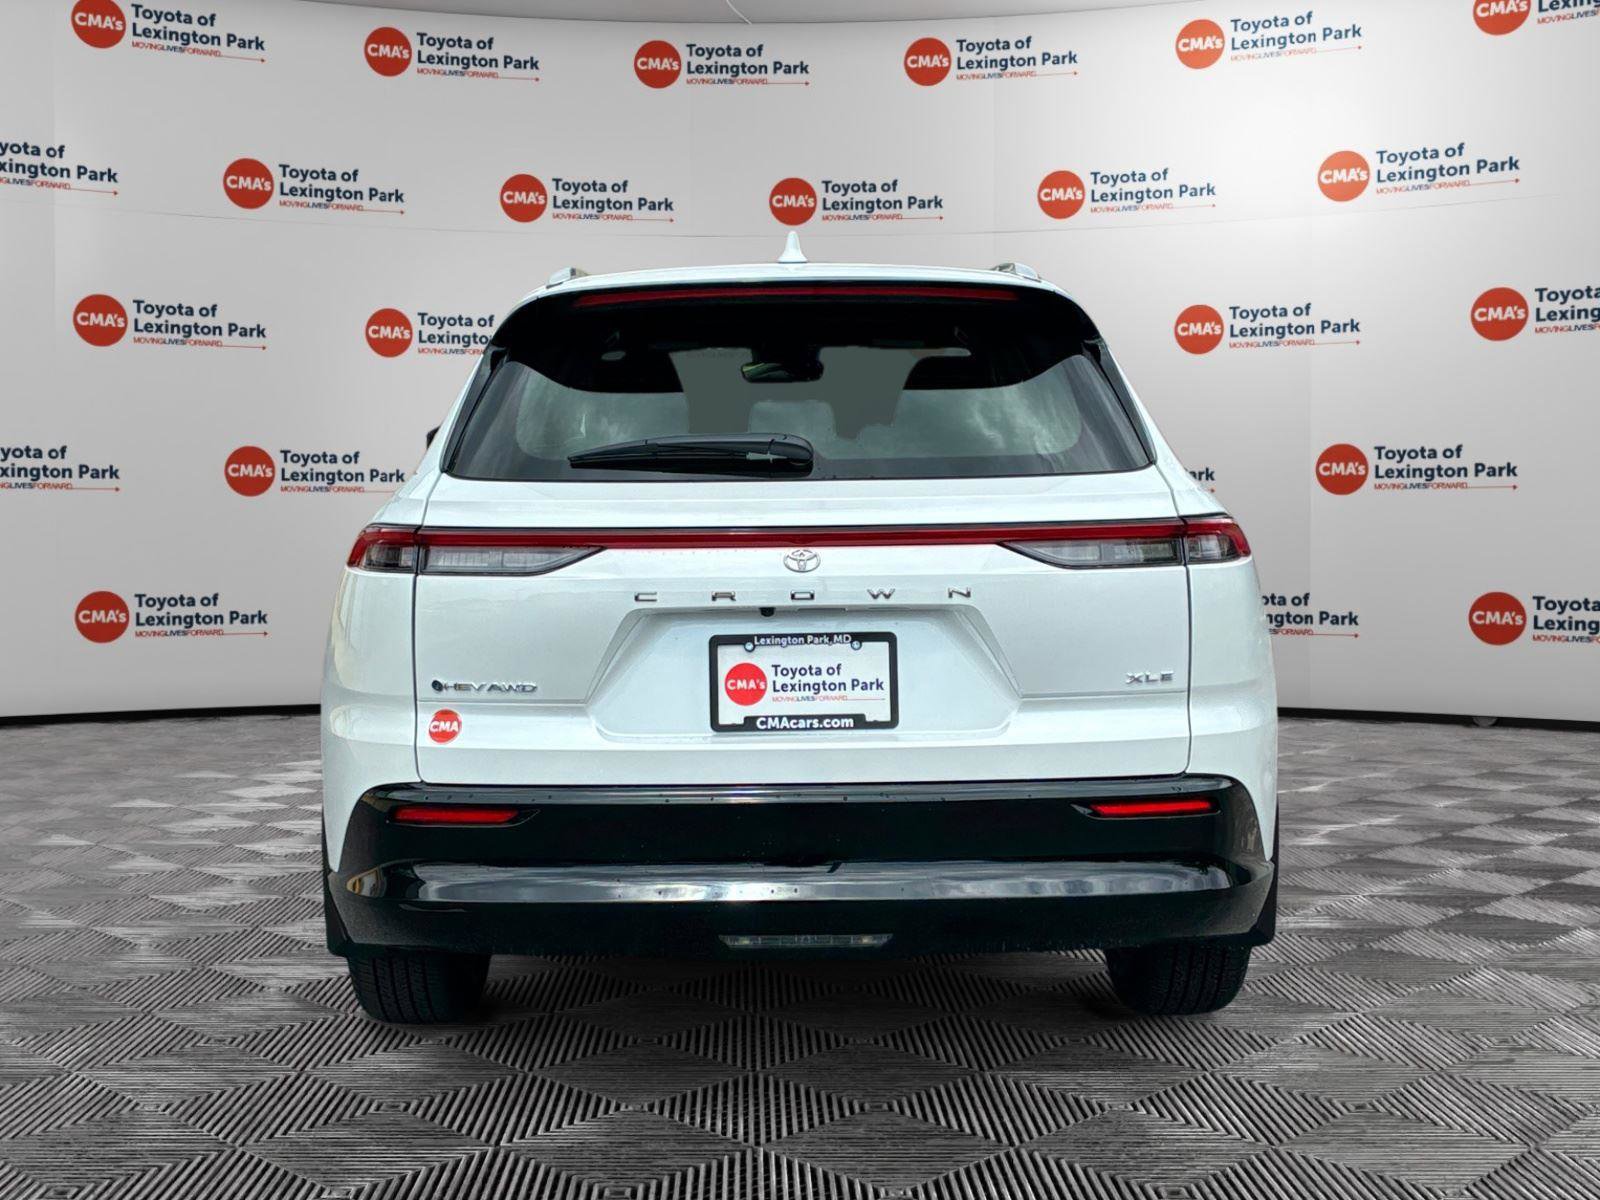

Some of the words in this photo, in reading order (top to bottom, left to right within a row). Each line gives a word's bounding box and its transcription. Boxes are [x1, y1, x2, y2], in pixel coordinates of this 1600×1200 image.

[131, 4, 193, 25] Toyota
[197, 14, 217, 27] of
[1476, 0, 1529, 17] CMA's
[74, 11, 125, 31] CMA's
[1230, 16, 1290, 34] Toyota
[1294, 11, 1313, 26] of
[132, 23, 221, 47] Lexington
[227, 34, 266, 51] Park
[416, 33, 473, 51] Toyota
[477, 37, 494, 50] of
[956, 38, 1011, 56] Toyota
[1014, 36, 1032, 50] of
[1178, 36, 1224, 52] CMA's
[1231, 32, 1317, 51] Lexington
[1322, 24, 1362, 41] Park
[367, 44, 411, 60] CMA's
[417, 50, 499, 71] Lexington
[503, 56, 540, 70] Park
[686, 44, 742, 61] Toyota
[746, 44, 764, 58] of
[637, 57, 680, 71] CMA's
[687, 60, 768, 78] Lexington
[773, 61, 810, 75] Park
[907, 54, 950, 69] CMA's
[957, 55, 1037, 72] Lexington
[1042, 51, 1078, 66] Park
[0, 142, 41, 157] yota
[45, 144, 66, 159] of
[1376, 147, 1440, 167] Toyota
[1444, 142, 1465, 158] of
[0, 158, 71, 179] xington
[77, 165, 119, 184] Park
[279, 164, 337, 183] Toyota
[341, 168, 359, 183] of
[1090, 170, 1147, 188] Toyota
[1151, 167, 1168, 181] of
[1320, 168, 1368, 184] CMA's
[1377, 164, 1470, 183] Lexington
[1476, 156, 1520, 174] Park
[226, 175, 272, 192] CMA's
[280, 182, 364, 203] Lexington
[368, 187, 404, 203] Park
[552, 178, 607, 196] Toyota
[611, 179, 628, 193] of
[822, 180, 877, 197] Toyota
[880, 179, 898, 193] of
[502, 190, 546, 205] CMA's
[772, 194, 815, 208] CMA's
[1040, 187, 1083, 202] CMA's
[1091, 187, 1173, 204] Lexington
[1179, 183, 1216, 198] Park
[552, 195, 633, 214] Lexington
[637, 198, 674, 212] Park
[823, 197, 903, 214] Lexington
[907, 195, 943, 210] Park
[1535, 286, 1600, 306] Toyota
[133, 300, 195, 319] Toyota
[199, 304, 218, 318] of
[1228, 306, 1288, 323] Toyota
[1293, 302, 1311, 317] of
[1474, 305, 1527, 322] CMA's
[1535, 307, 1600, 323] Lexing
[76, 311, 126, 328] CMA's
[134, 318, 223, 339] Lexington
[228, 322, 267, 339] Park
[418, 312, 474, 330] Toyota
[477, 314, 495, 328] of
[368, 325, 412, 340] CMA's
[1177, 321, 1222, 337] CMA's
[1229, 322, 1315, 340] Lexington
[1320, 318, 1361, 334] Park
[418, 330, 492, 347] Lexingto
[0, 446, 43, 463] yota
[47, 445, 68, 460] of
[280, 450, 338, 468] Toyota
[342, 450, 361, 465] of
[1374, 445, 1438, 464] Toyota
[1442, 444, 1463, 460] of
[0, 462, 73, 482] xington
[78, 464, 120, 480] Park
[227, 463, 273, 479] CMA's
[281, 467, 365, 486] Lexington
[369, 468, 405, 483] Park
[1318, 461, 1366, 476] CMA's
[1375, 464, 1468, 482] Lexington
[1474, 461, 1518, 478] Park
[135, 594, 196, 612] Toyota
[200, 592, 219, 607] of
[634, 587, 972, 602] CROWN
[1262, 592, 1287, 607] ota
[1290, 592, 1310, 607] of
[1533, 596, 1600, 616] Toyota
[78, 609, 128, 625] CMA's
[136, 611, 224, 630] Lexington
[230, 610, 268, 625] Park
[1266, 611, 1314, 629] ngton
[1318, 610, 1359, 626] Park
[1471, 610, 1524, 626] CMA's
[1533, 615, 1600, 636] Lexing
[754, 635, 805, 648] Lexington
[771, 664, 823, 680] Toyota
[826, 663, 842, 676] of
[1125, 670, 1174, 684] XLE
[726, 678, 766, 691] CMA's
[772, 679, 847, 695] Lexington
[851, 678, 885, 691] Park
[430, 720, 459, 733] CMA
[755, 716, 855, 730] CMAcars.com
